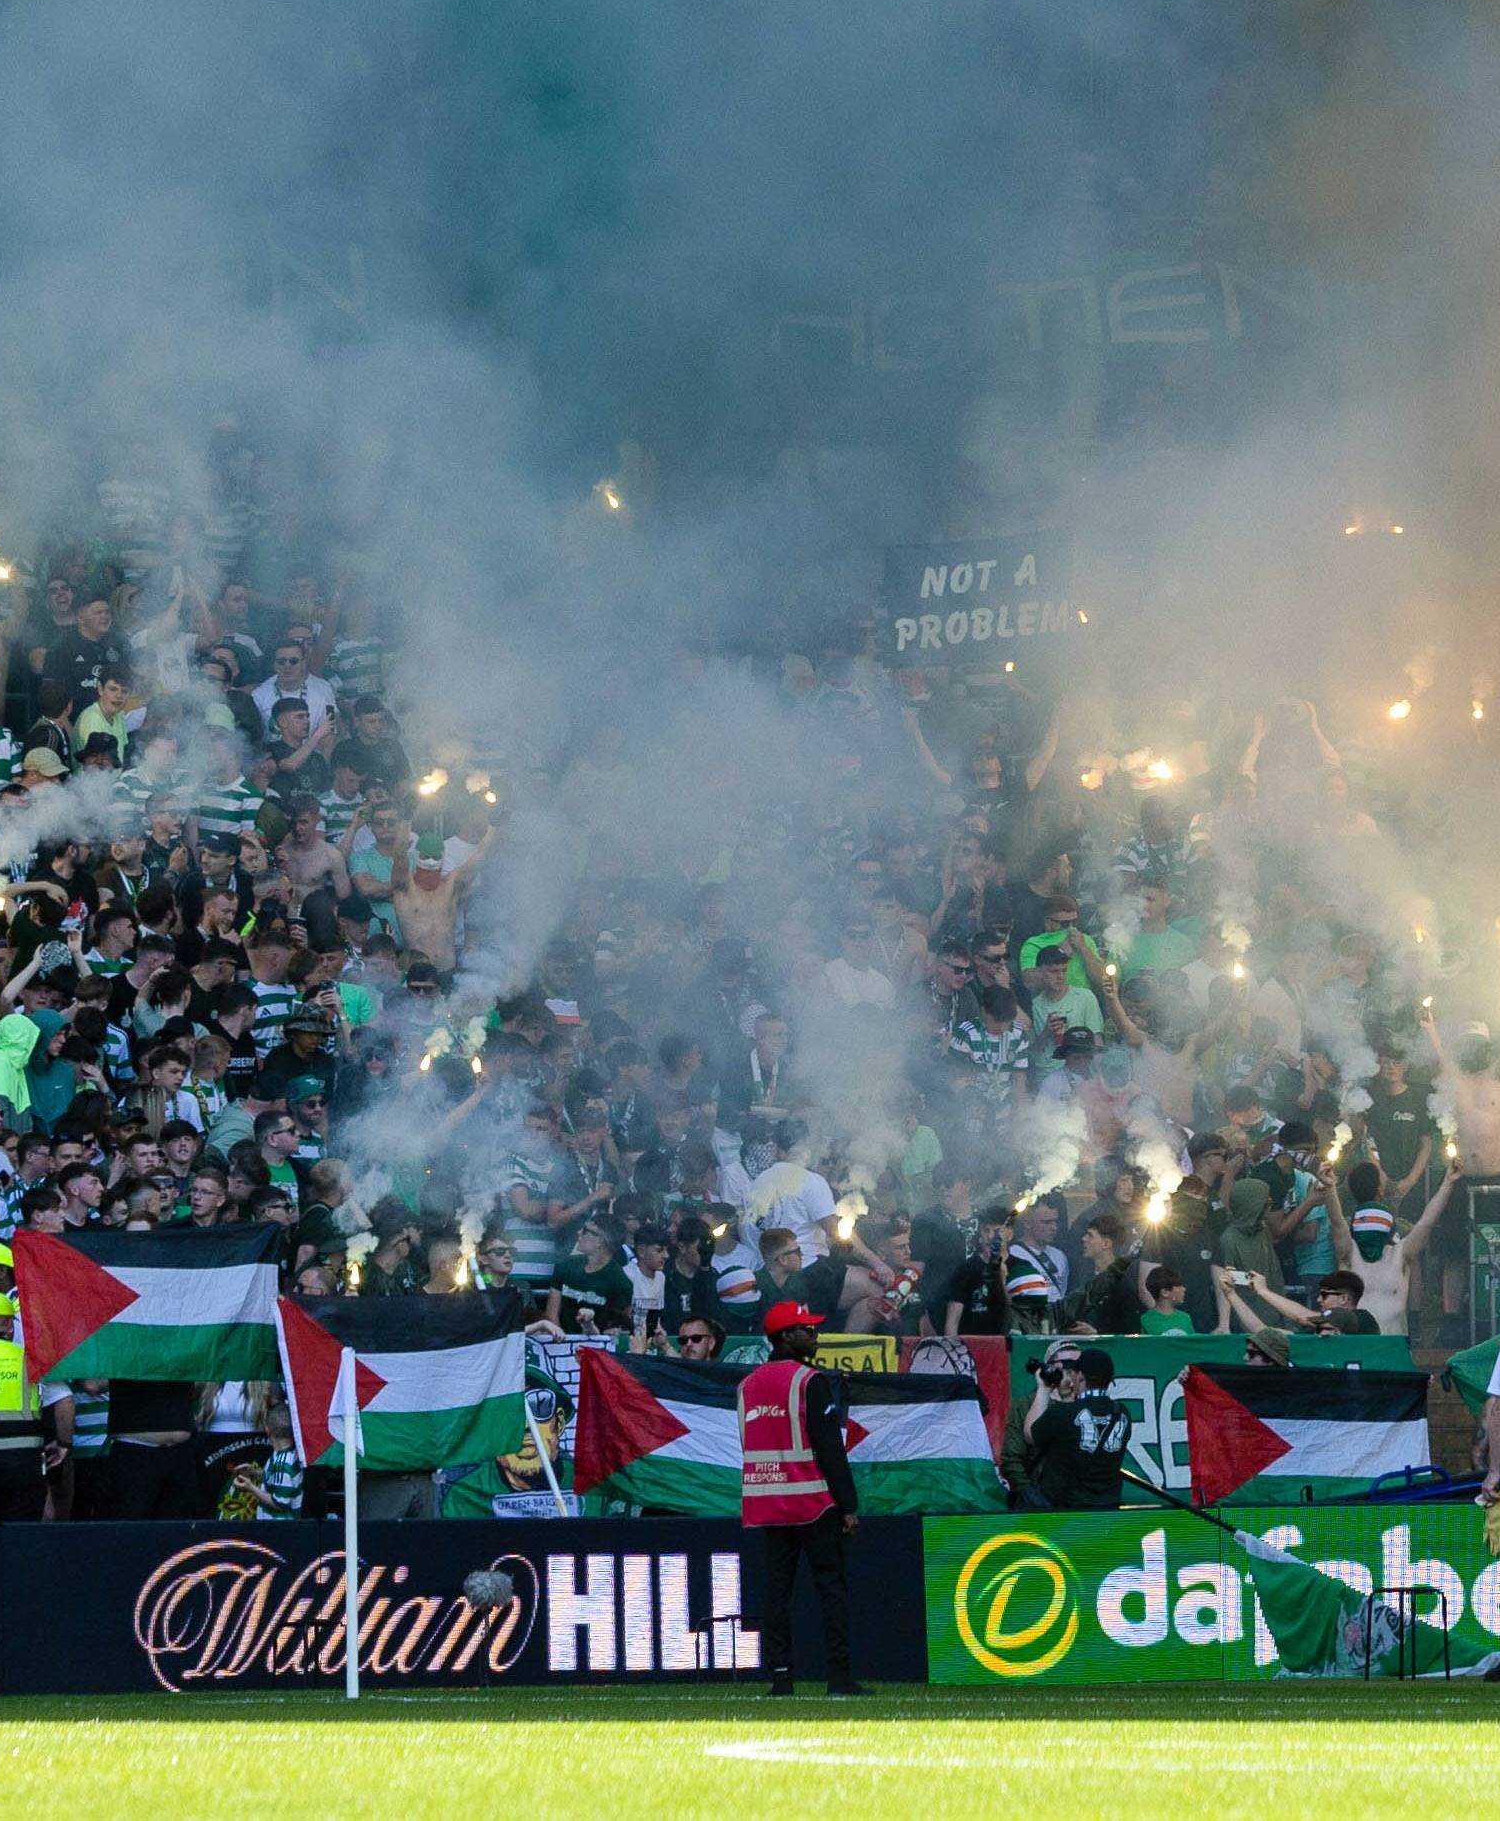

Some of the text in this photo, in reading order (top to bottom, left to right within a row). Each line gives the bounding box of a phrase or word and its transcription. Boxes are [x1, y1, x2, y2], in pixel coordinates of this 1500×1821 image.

[920, 554, 1037, 599] NOT A
[895, 600, 1069, 652] PROBLEM
[755, 1462, 780, 1473] PITCH
[134, 1538, 761, 1693] William HILL
